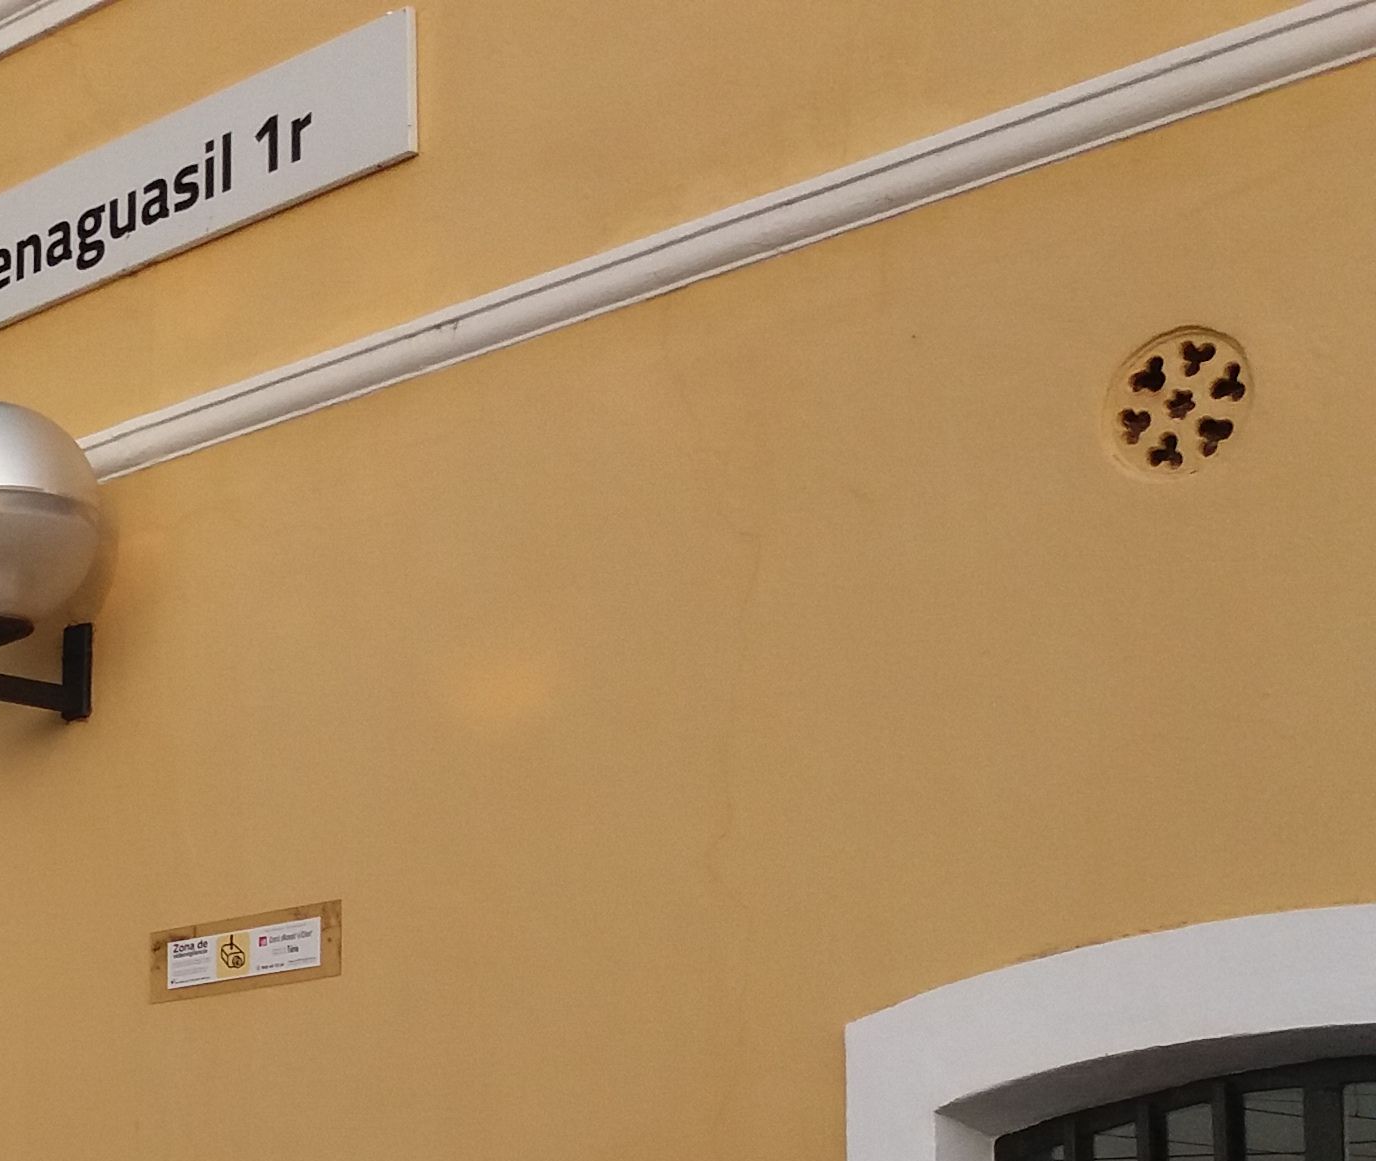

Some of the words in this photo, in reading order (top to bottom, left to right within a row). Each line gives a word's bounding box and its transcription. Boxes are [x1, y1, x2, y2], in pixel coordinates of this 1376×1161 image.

[254, 111, 313, 174] 1r
[173, 943, 195, 953] Zona
[197, 939, 208, 949] de
